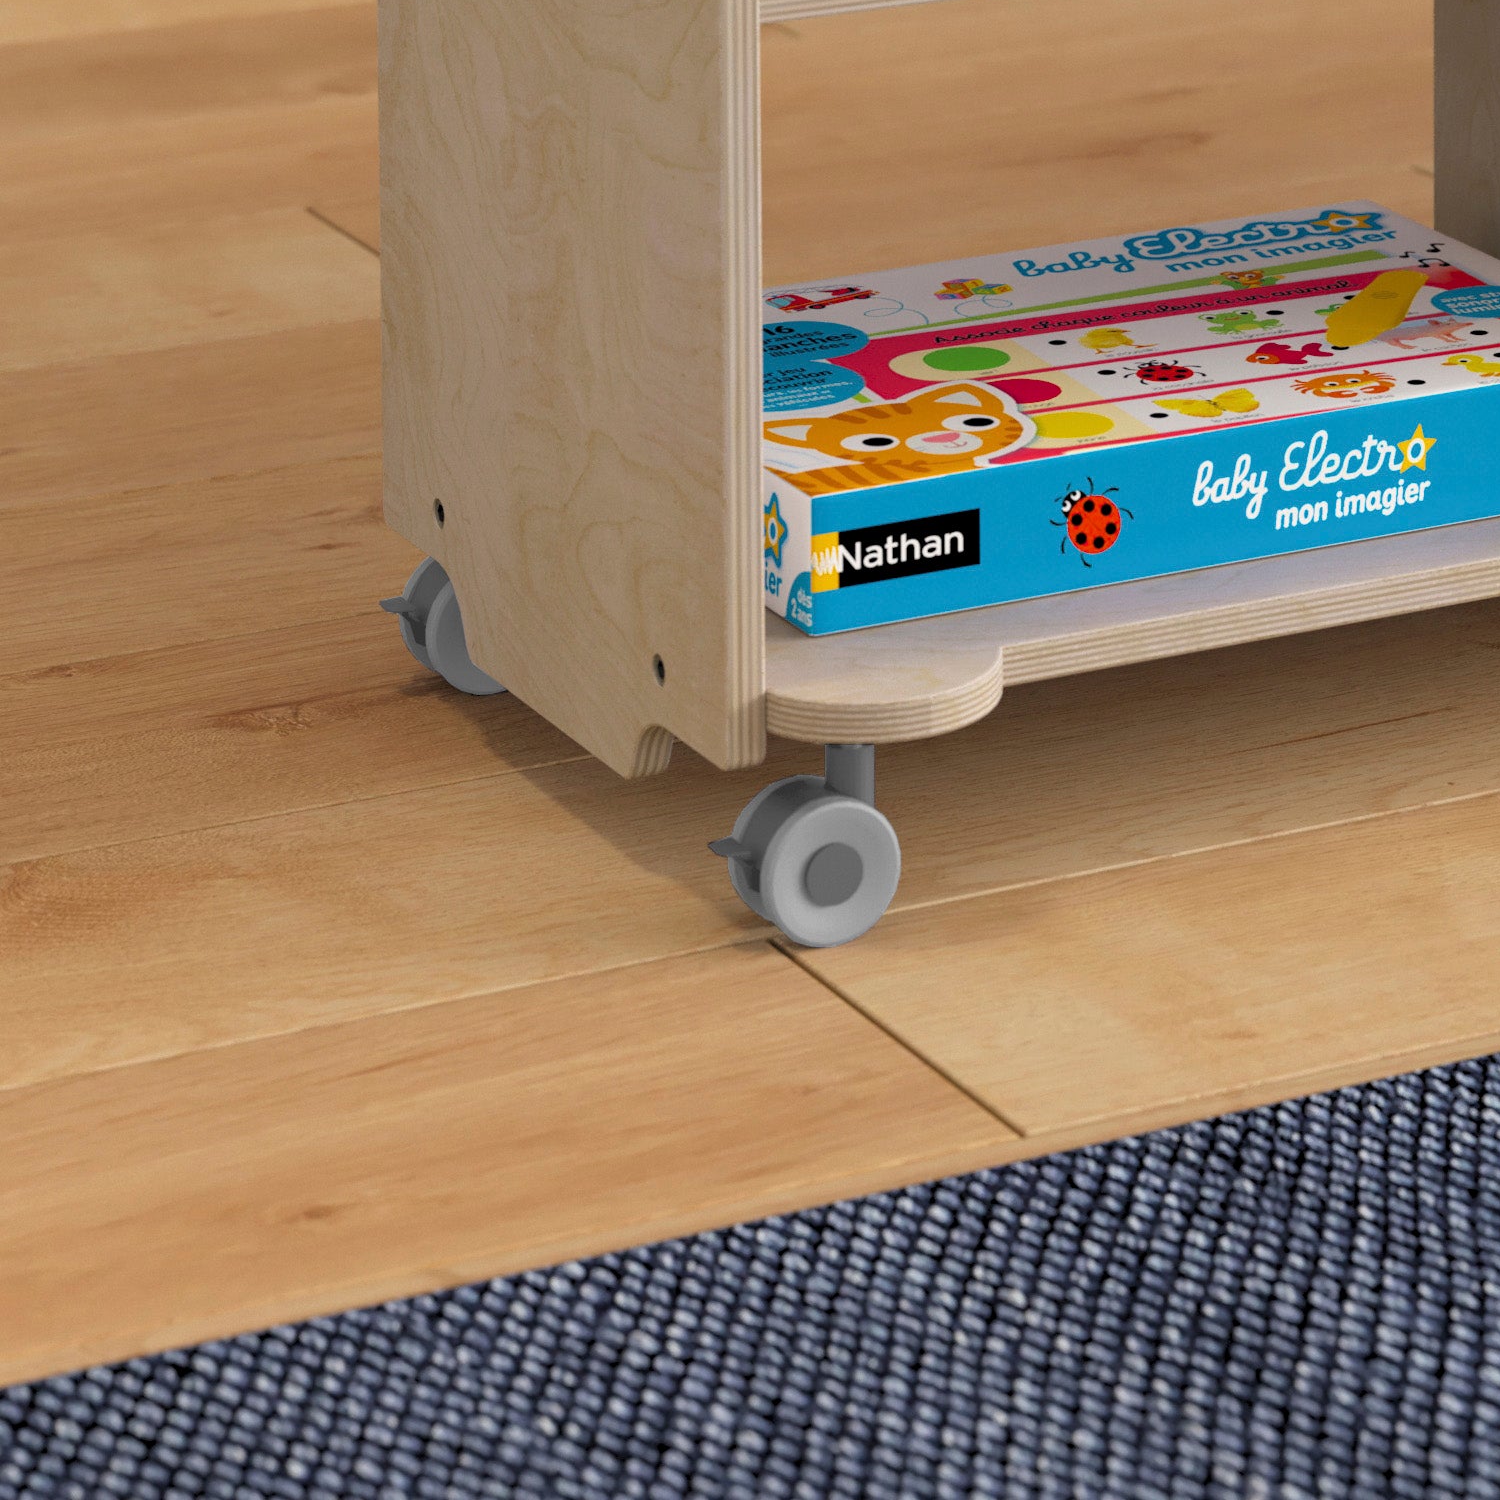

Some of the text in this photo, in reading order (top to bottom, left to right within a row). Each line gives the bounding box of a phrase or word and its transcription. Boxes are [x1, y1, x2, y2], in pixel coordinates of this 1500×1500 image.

[1012, 213, 1362, 277] baby Electro
[1166, 229, 1398, 273] mon imagier
[934, 322, 1024, 346] Associe
[1034, 310, 1115, 332] chaque
[1120, 299, 1214, 320] couleur
[1239, 293, 1267, 303] un
[1439, 292, 1480, 303] avec
[1192, 429, 1426, 520] baby Electro
[1275, 479, 1431, 530] mon imagier
[838, 530, 965, 573] Nathan
[791, 598, 798, 619] 2
